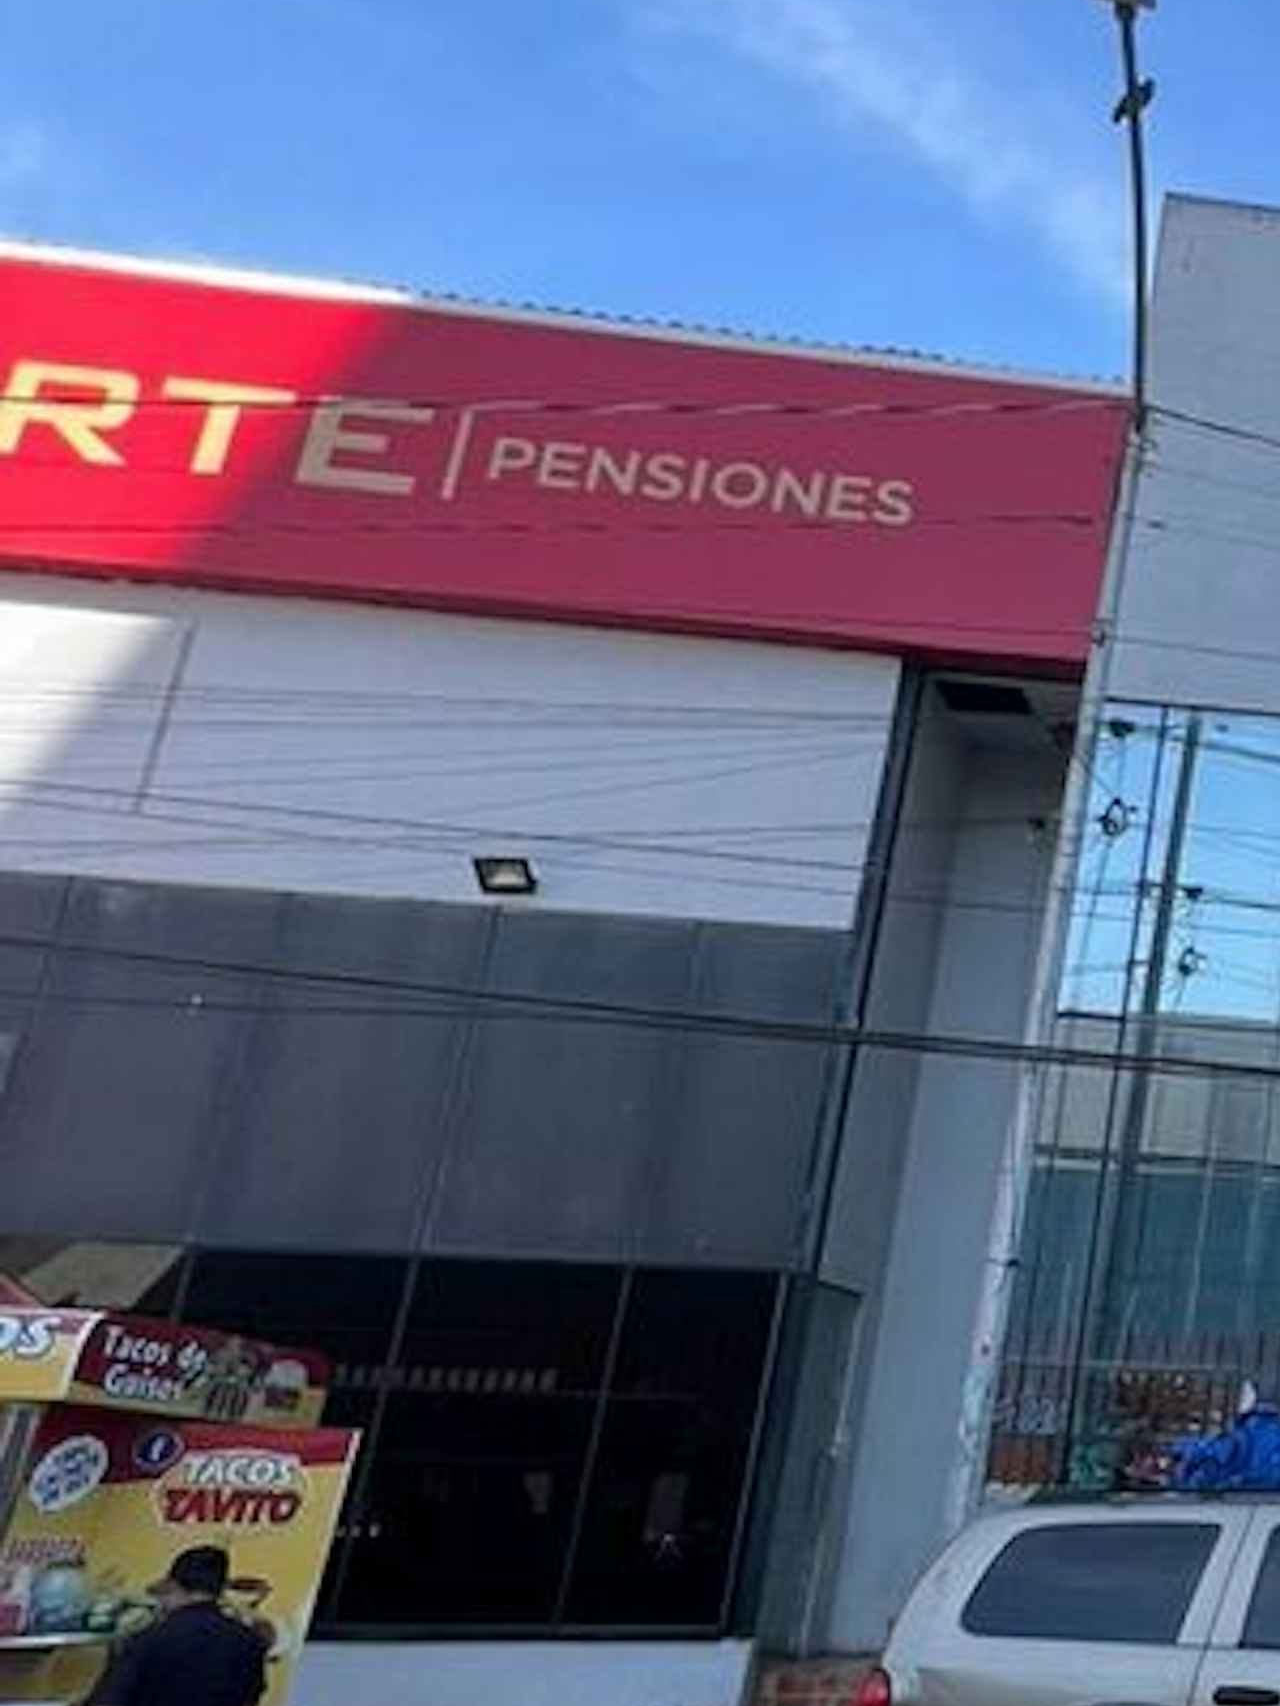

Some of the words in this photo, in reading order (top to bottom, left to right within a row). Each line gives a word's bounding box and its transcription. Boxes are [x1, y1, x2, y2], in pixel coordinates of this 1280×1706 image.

[487, 435, 916, 526] PENSIONES
[104, 1325, 171, 1367] Tacos
[182, 1453, 296, 1487] TACOS
